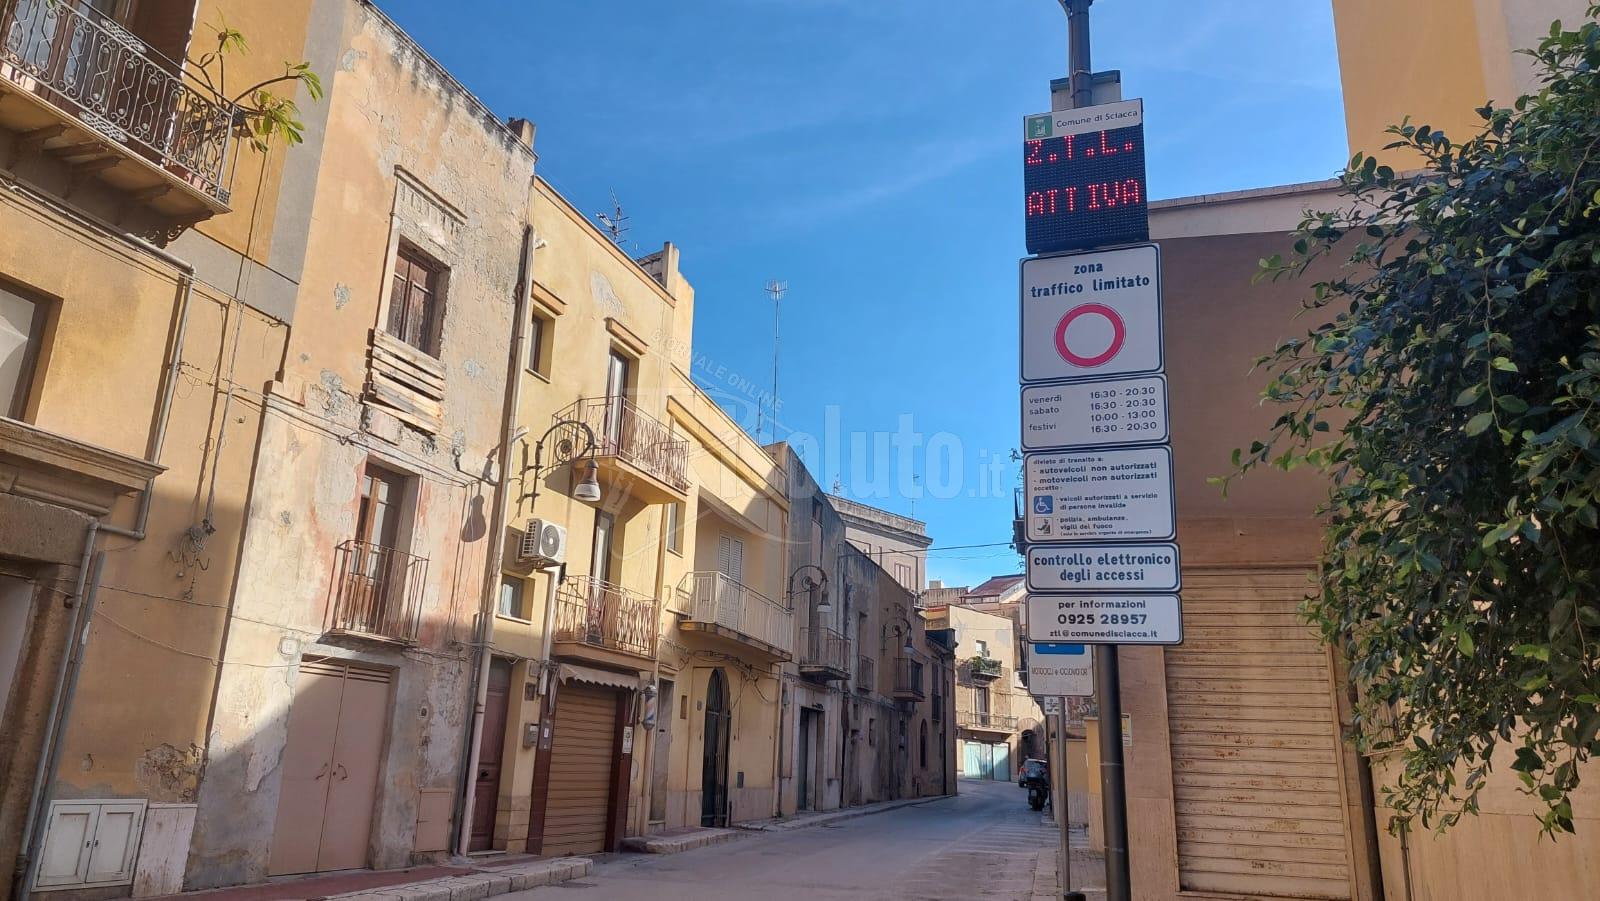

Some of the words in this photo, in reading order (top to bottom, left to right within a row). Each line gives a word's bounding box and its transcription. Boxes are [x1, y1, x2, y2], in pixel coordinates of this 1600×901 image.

[1056, 117, 1091, 128] Comune
[1095, 114, 1102, 122] di
[1105, 110, 1138, 121] Sciacca
[1027, 130, 1133, 164] Z.T.L.
[1028, 179, 1140, 216] ATTIVA
[1074, 262, 1103, 275] zona
[1031, 282, 1083, 298] traffico
[1093, 275, 1150, 291] limitato
[1029, 406, 1060, 415] sabato
[1029, 422, 1057, 431] festivi
[1039, 466, 1087, 474] autoveicoli
[1110, 462, 1157, 471] autorizzati
[1039, 475, 1089, 484] motoveicoli
[1110, 472, 1158, 481] autorizzati
[1034, 553, 1092, 566] controllo
[1098, 553, 1171, 565] elettronico
[1060, 569, 1090, 582] degli
[1096, 569, 1144, 581] accessi
[1058, 601, 1075, 610] per
[1080, 600, 1146, 609] informazioni
[1058, 614, 1095, 624] 0925
[1100, 614, 1147, 624] 28957
